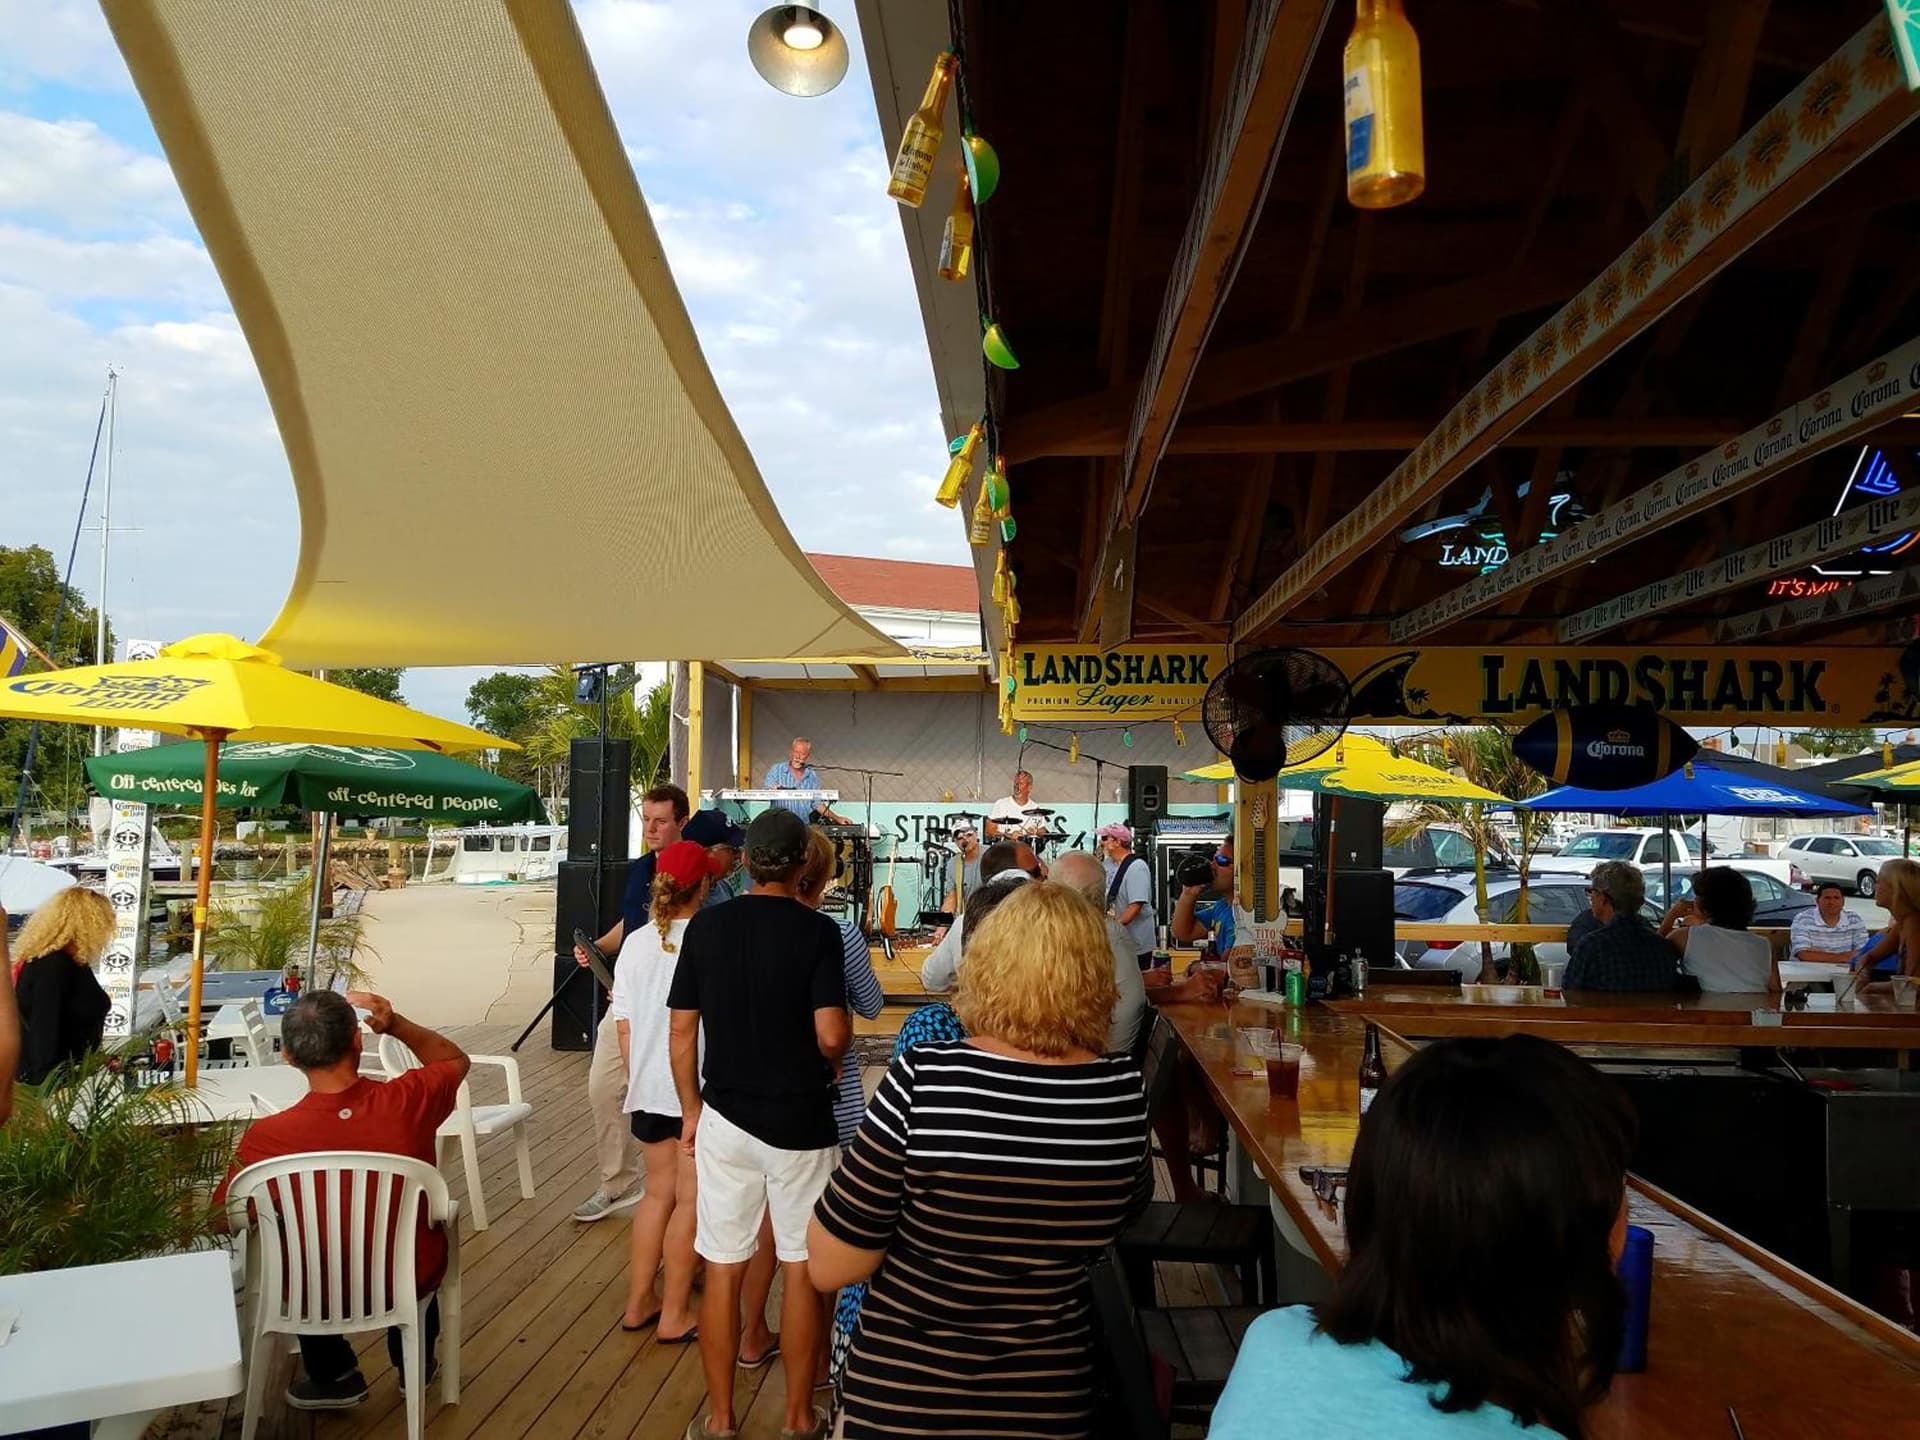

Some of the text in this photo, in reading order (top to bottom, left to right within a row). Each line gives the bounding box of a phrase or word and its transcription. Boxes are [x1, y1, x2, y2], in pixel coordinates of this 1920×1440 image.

[1712, 456, 1749, 486] Corona
[1754, 433, 1793, 466] Corona
[1800, 407, 1842, 443] Corona
[1851, 379, 1900, 418] Corona
[1685, 570, 1705, 596] Lite
[1725, 555, 1745, 583] Lite
[1768, 539, 1793, 568] Lite
[1818, 519, 1842, 551] Lite
[1868, 500, 1900, 534] Lite
[1767, 577, 1805, 597] IT'S
[1023, 652, 1209, 686] LANDSHARK
[9, 679, 188, 701] Corona
[1481, 655, 1827, 713] LANDSHARK
[1076, 684, 1155, 714] Lager
[1586, 739, 1647, 760] Corona
[110, 774, 203, 793] Off-centered
[240, 780, 260, 797] for
[328, 787, 503, 812] off-centered people.
